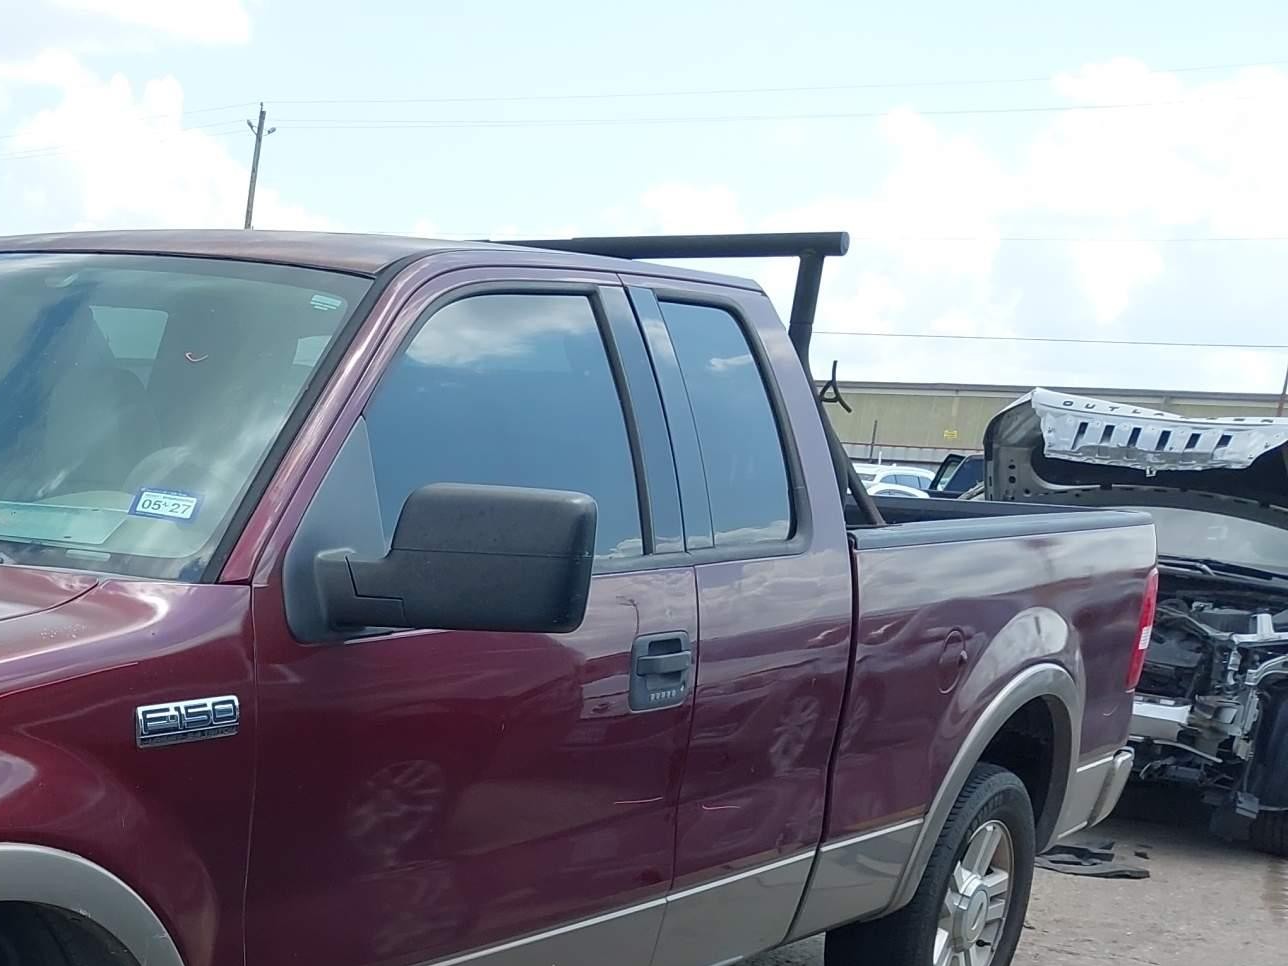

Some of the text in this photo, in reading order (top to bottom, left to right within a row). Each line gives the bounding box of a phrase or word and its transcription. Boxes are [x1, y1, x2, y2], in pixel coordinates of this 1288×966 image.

[1062, 400, 1274, 423] OUTLA
[141, 499, 191, 514] 05 27
[142, 699, 237, 734] F-150
